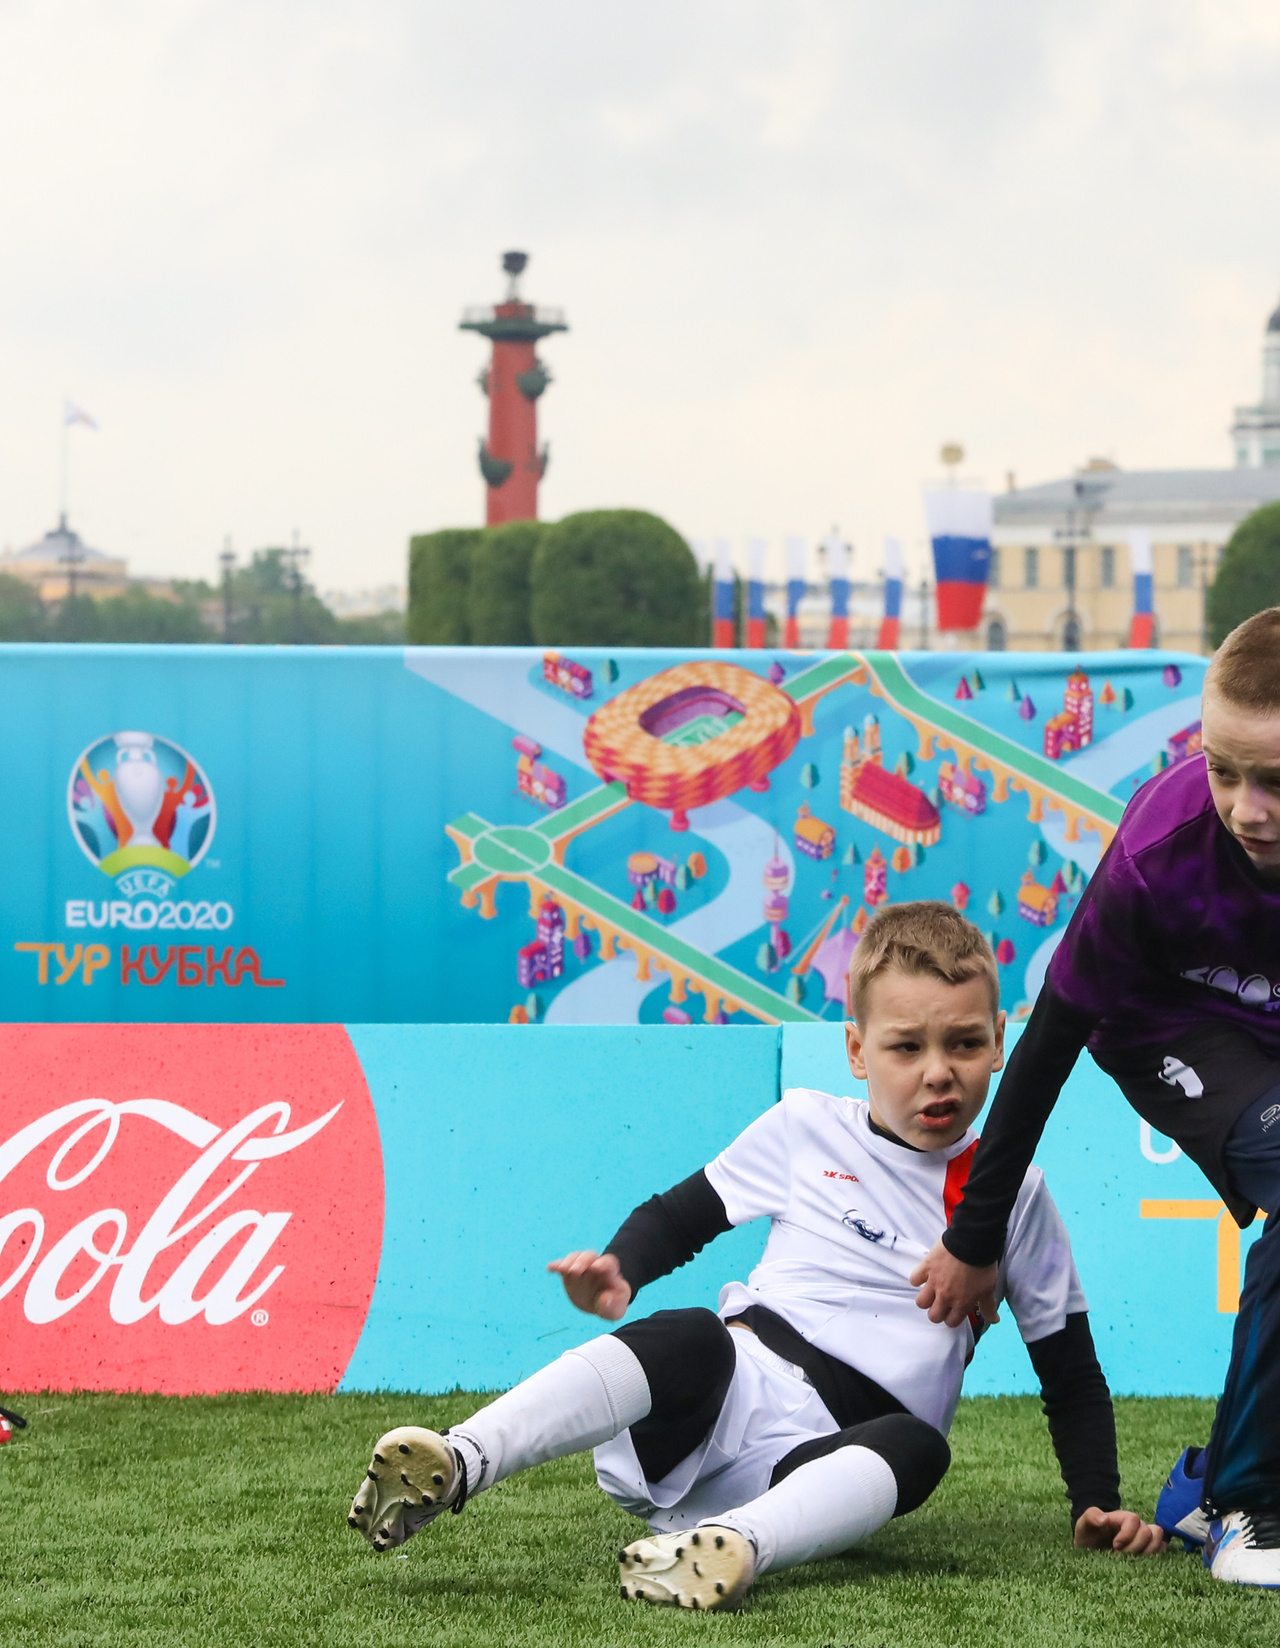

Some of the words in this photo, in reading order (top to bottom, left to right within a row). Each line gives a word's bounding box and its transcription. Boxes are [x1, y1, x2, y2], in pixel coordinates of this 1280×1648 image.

[118, 873, 171, 896] UEFA
[66, 900, 233, 930] EURO2020
[15, 942, 111, 985] ТУР
[121, 945, 286, 987] КУБКА
